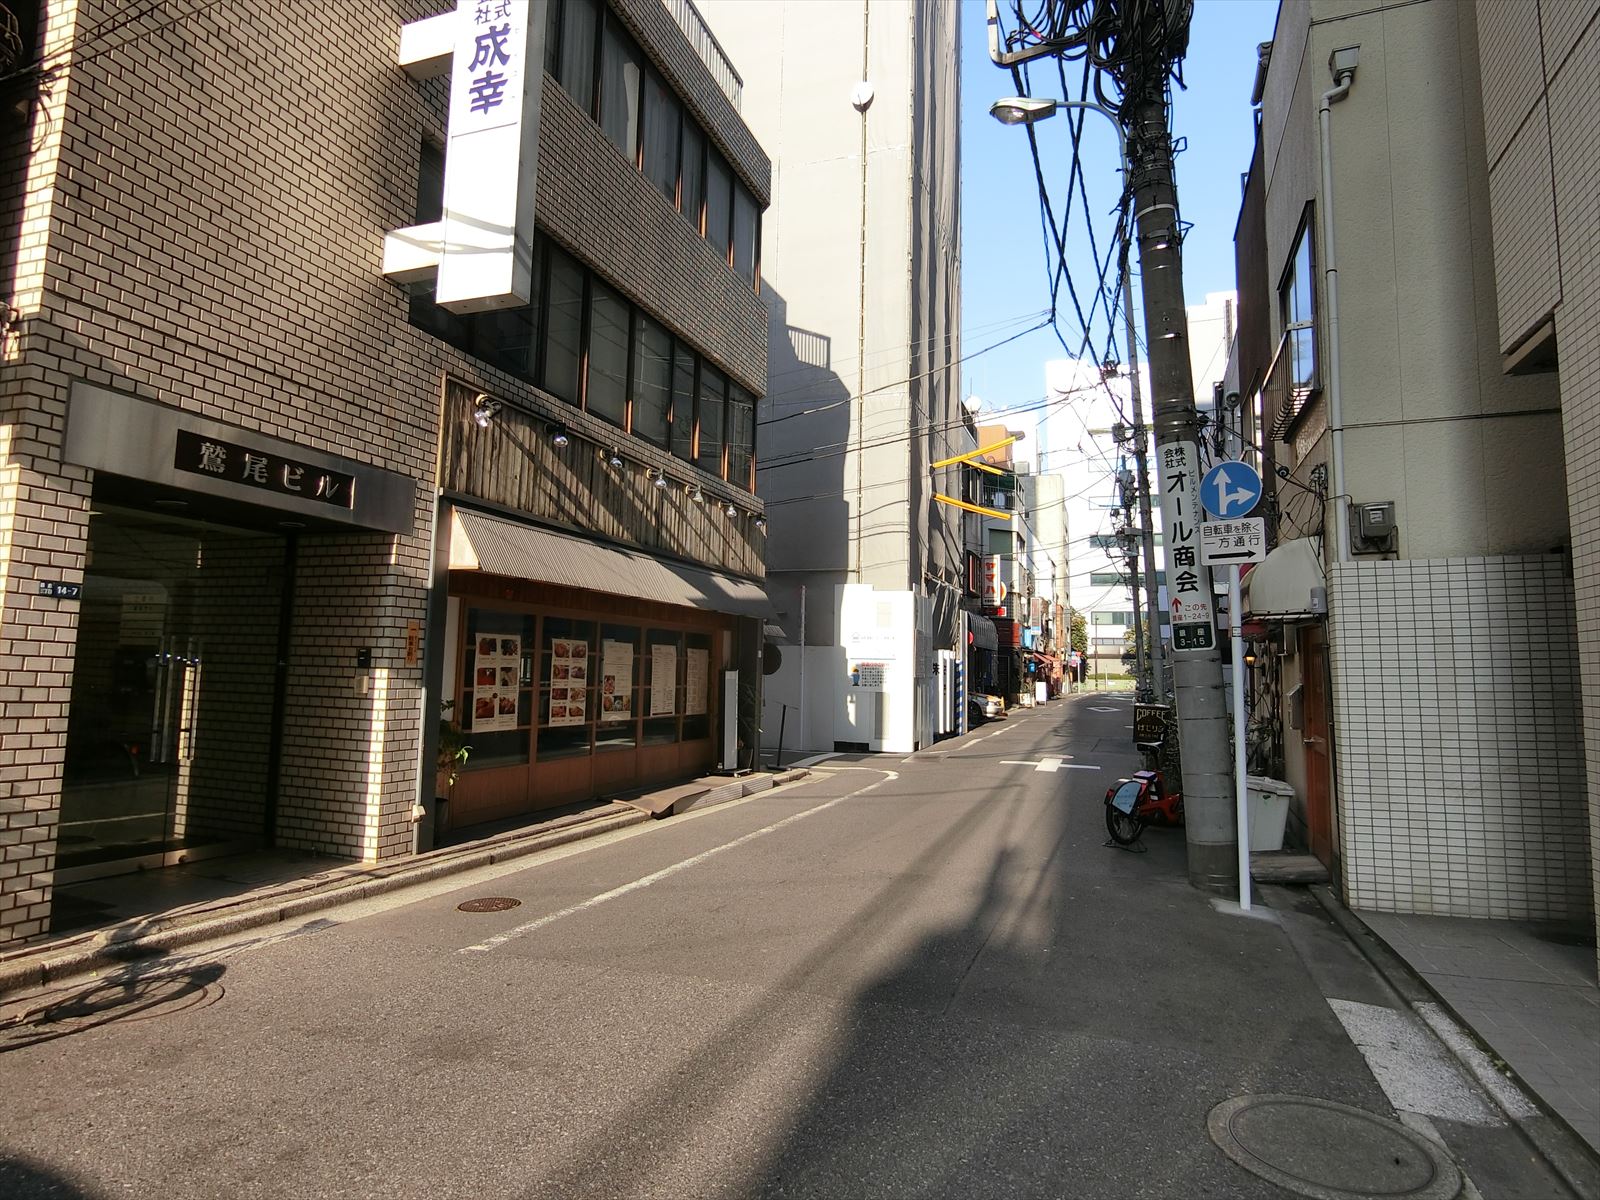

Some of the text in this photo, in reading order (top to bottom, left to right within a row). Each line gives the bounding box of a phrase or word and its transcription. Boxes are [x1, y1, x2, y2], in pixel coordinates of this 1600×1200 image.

[468, 23, 511, 115] 成幸
[198, 442, 339, 498] 鷲尾ビル
[1167, 471, 1199, 593] オール商会
[1203, 522, 1260, 536] 自転車を除く
[1204, 535, 1261, 548] 一方通行
[57, 586, 78, 596] 14-7
[1185, 603, 1207, 611] この先
[1180, 637, 1205, 646] 3-15
